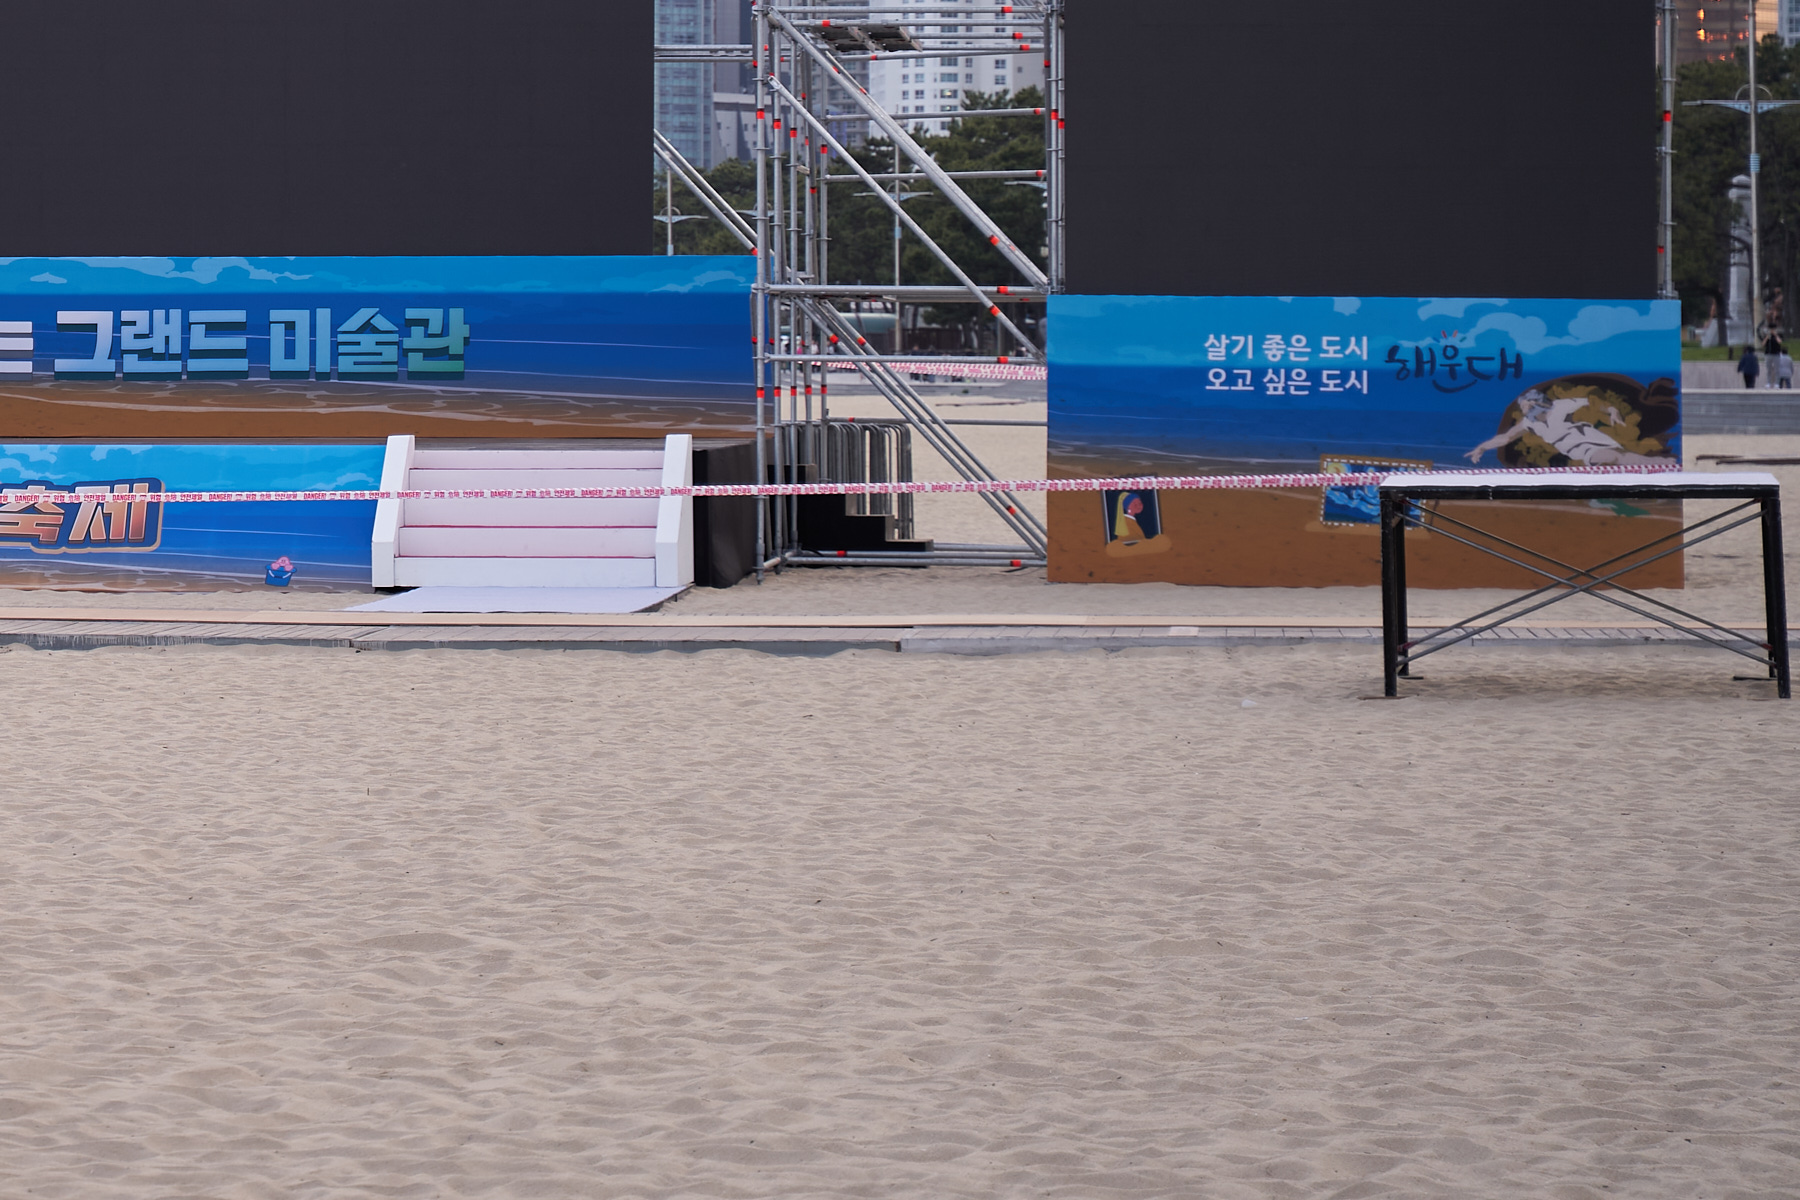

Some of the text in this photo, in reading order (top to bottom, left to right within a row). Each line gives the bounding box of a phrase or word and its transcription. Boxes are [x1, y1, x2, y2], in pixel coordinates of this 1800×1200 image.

[54, 308, 249, 377] 그랜드
[269, 307, 470, 376] 미술관
[1203, 333, 1368, 361] 살기 좋은 도시
[1205, 368, 1368, 395] 오고 싶은 도시
[1384, 344, 1524, 394] 해운대
